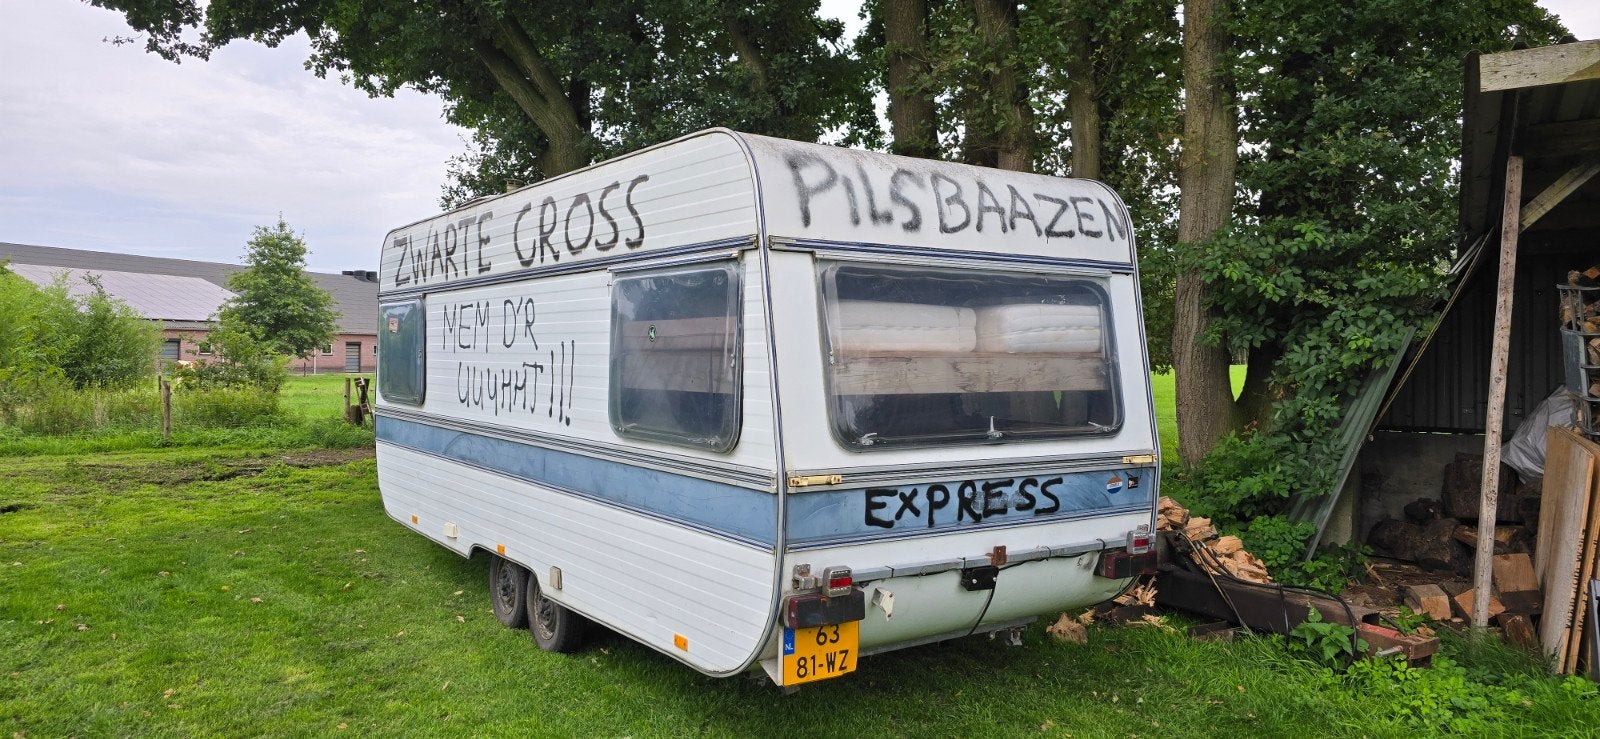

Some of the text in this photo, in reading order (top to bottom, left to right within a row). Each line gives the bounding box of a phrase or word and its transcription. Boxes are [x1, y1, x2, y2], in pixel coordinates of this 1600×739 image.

[783, 152, 1126, 242] PILSBAAZEN
[393, 174, 649, 287] ZWARTE CROSS
[443, 296, 538, 353] MEM D'R
[865, 477, 1063, 528] EXPRESS
[785, 643, 794, 651] NL
[815, 624, 840, 646] 63
[796, 649, 849, 678] 81-WZ
